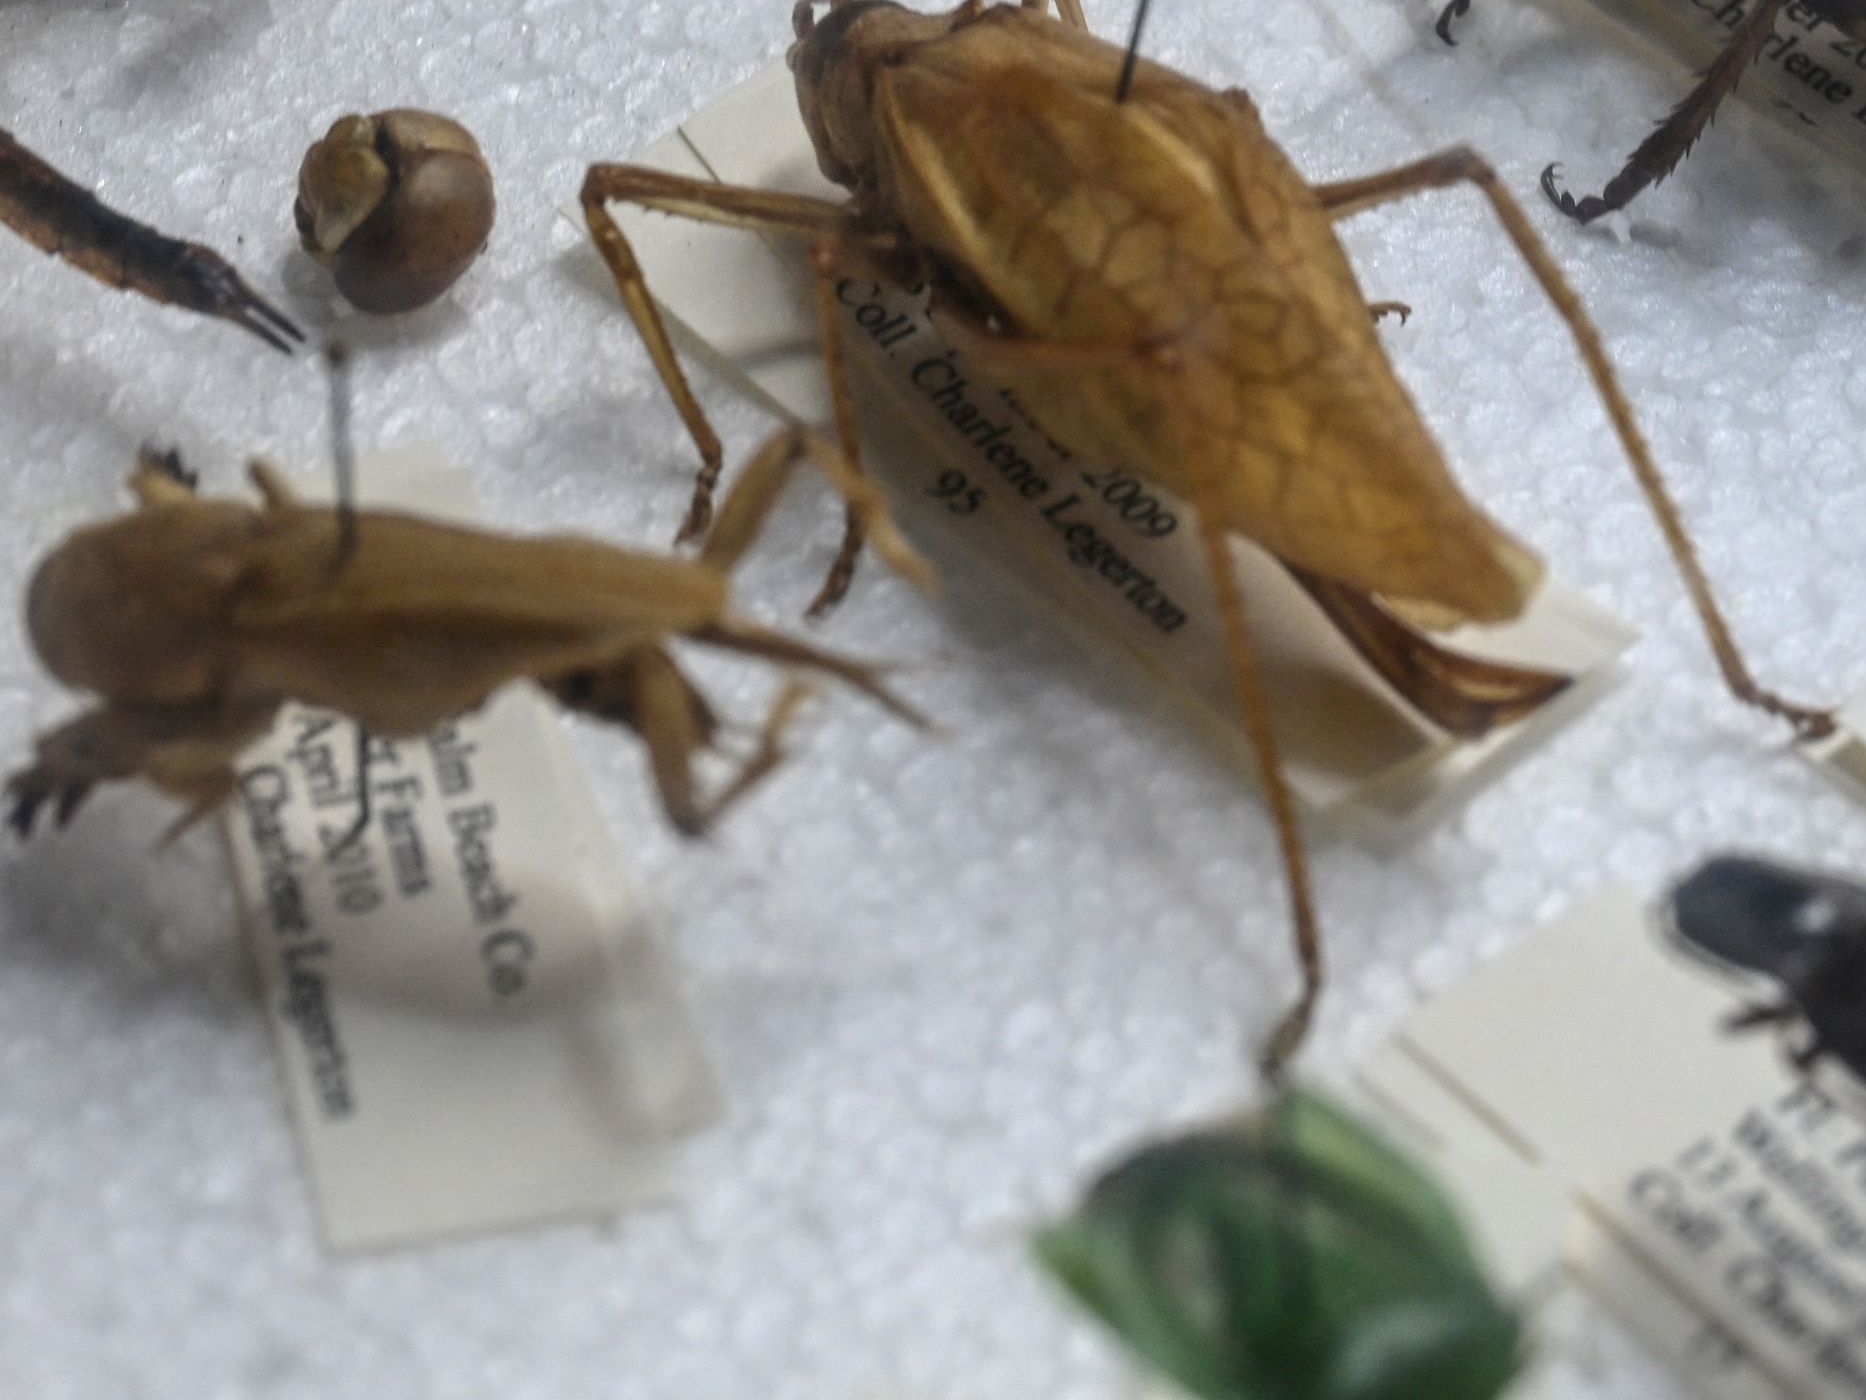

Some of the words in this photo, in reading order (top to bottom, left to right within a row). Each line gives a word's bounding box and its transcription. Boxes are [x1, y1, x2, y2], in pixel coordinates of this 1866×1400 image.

[911, 357, 1049, 498] Charlene
[1043, 493, 1188, 634] Legerton
[928, 468, 987, 516] 95
